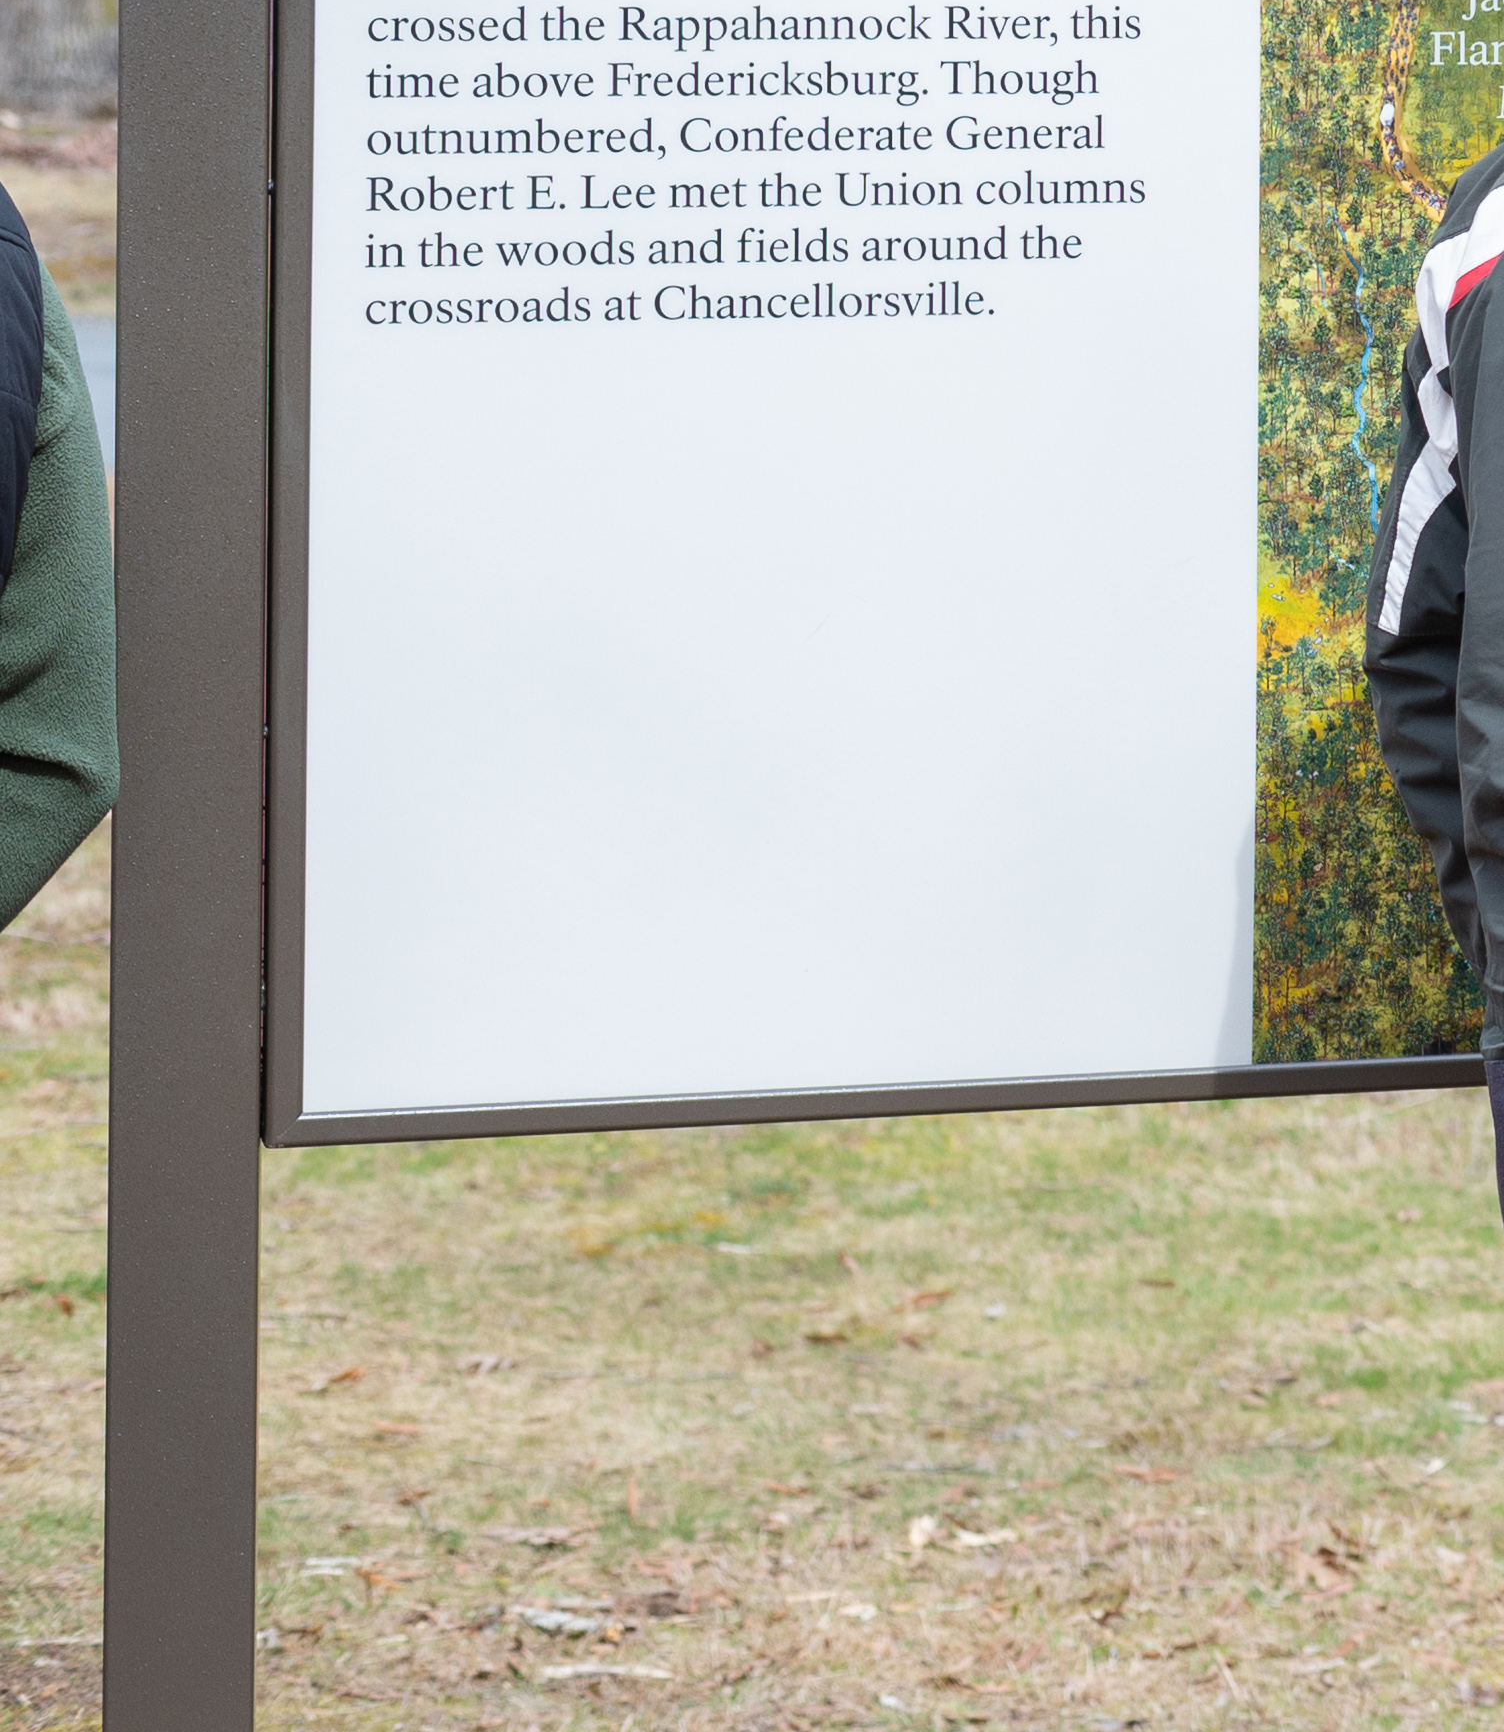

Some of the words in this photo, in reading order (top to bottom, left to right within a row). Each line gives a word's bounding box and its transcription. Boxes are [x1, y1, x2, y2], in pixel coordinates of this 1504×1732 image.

[367, 5, 528, 42] crossed
[539, 5, 605, 42] the
[618, 4, 932, 52] Rappahannock
[944, 5, 1058, 47] River,
[1070, 4, 1141, 40] this
[366, 63, 460, 99] time
[472, 61, 594, 98] above
[607, 60, 929, 107] Fredericksburg.
[940, 59, 1100, 106] Though
